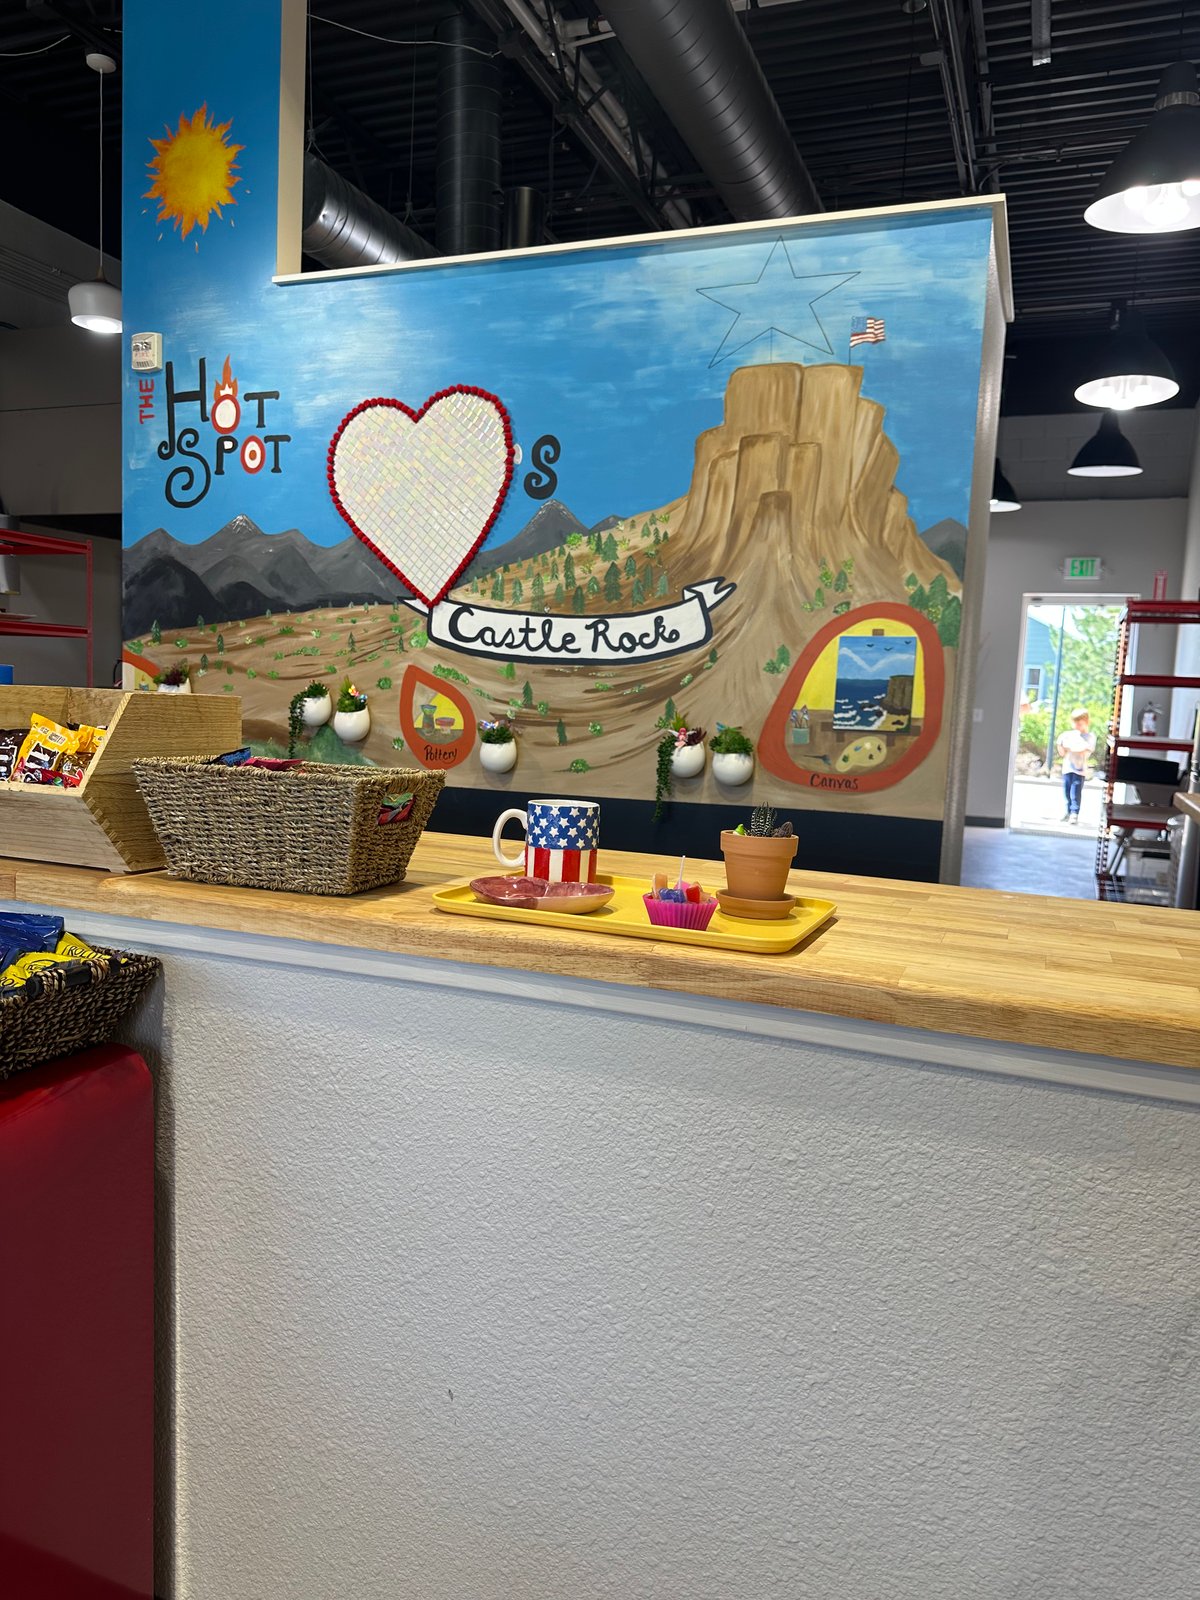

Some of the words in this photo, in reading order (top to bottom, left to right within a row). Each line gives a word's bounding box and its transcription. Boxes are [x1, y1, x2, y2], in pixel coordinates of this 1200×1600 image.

[138, 378, 155, 425] THE
[157, 354, 280, 460] HOT
[164, 427, 292, 509] SPOT
[1071, 558, 1097, 577] EXIT
[448, 606, 582, 653] Castle
[585, 615, 681, 653] Rock
[424, 744, 458, 764] Pottery
[809, 773, 860, 790] Canvas
